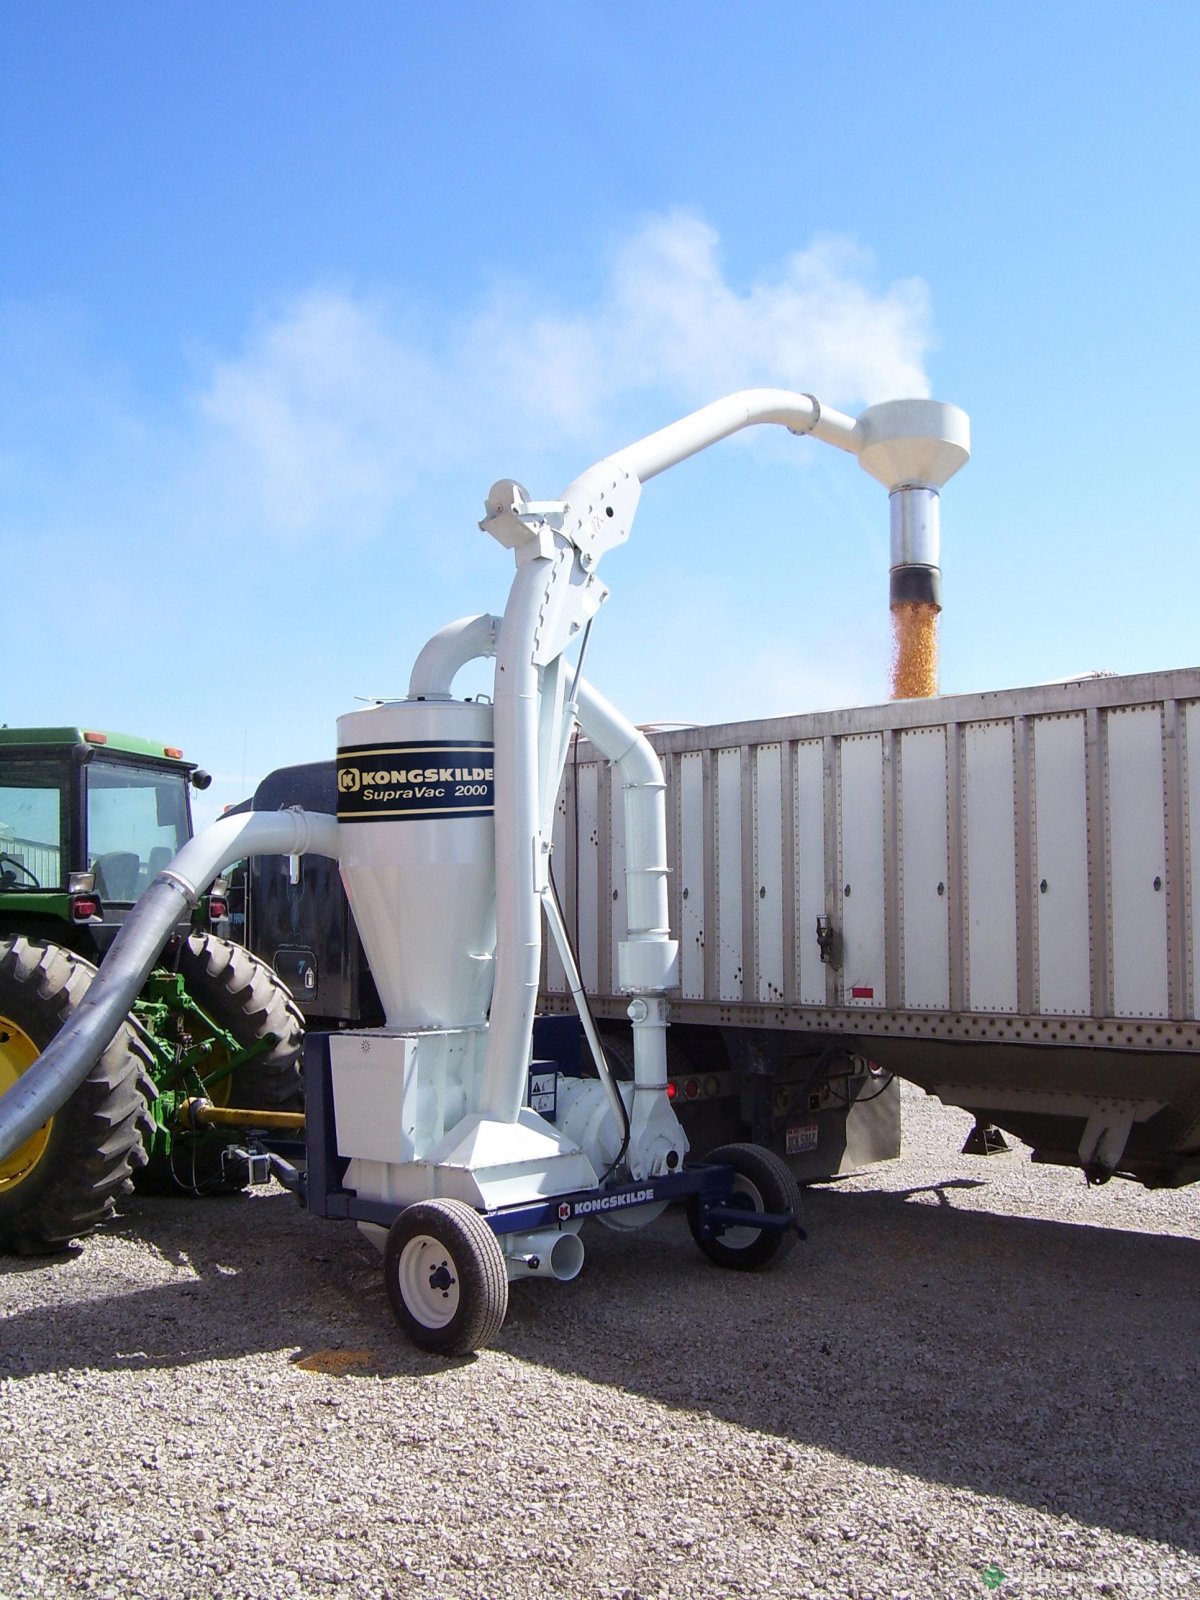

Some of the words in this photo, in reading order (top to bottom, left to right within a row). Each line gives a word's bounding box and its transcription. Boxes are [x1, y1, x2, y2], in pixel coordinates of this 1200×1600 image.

[362, 768, 494, 786] KONGSKILDE
[363, 787, 445, 802] SupraVac
[454, 785, 488, 796] 2000
[574, 1189, 654, 1215] KONGSKILDE
